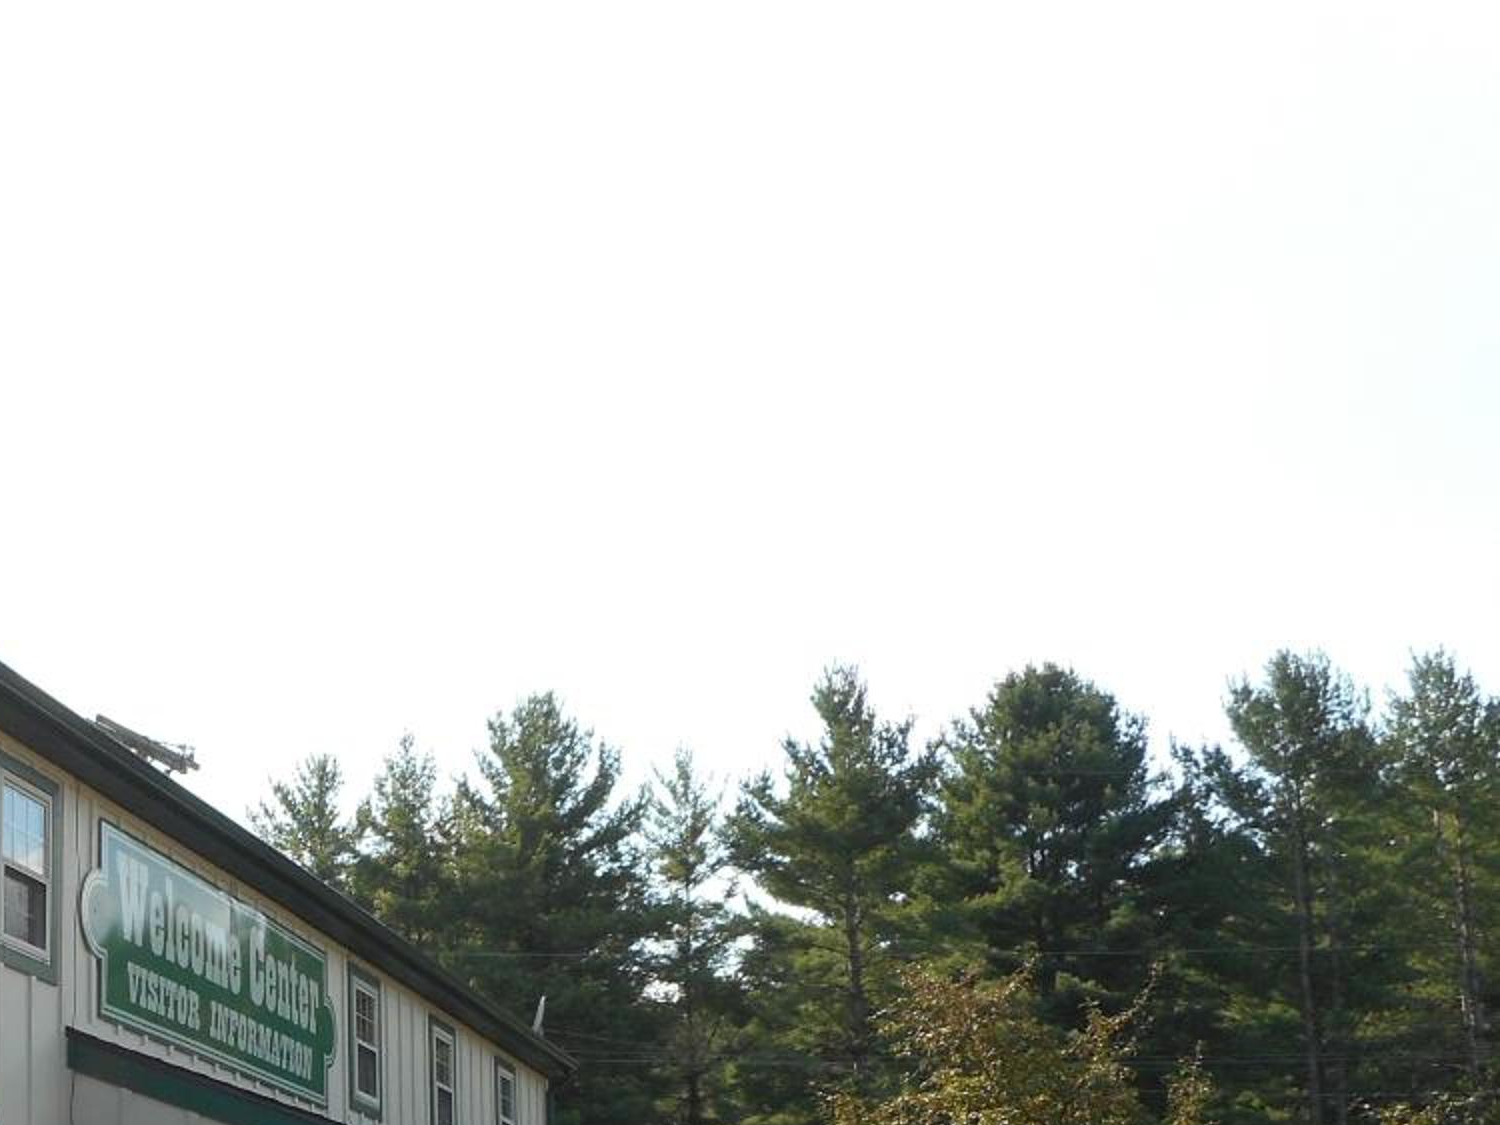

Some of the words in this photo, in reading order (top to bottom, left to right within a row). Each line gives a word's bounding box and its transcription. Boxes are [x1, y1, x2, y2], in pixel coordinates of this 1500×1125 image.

[115, 850, 242, 995] Welcome
[250, 921, 319, 1034] Center
[126, 961, 200, 1030] VISITOR
[209, 1001, 313, 1080] INFORMATION
